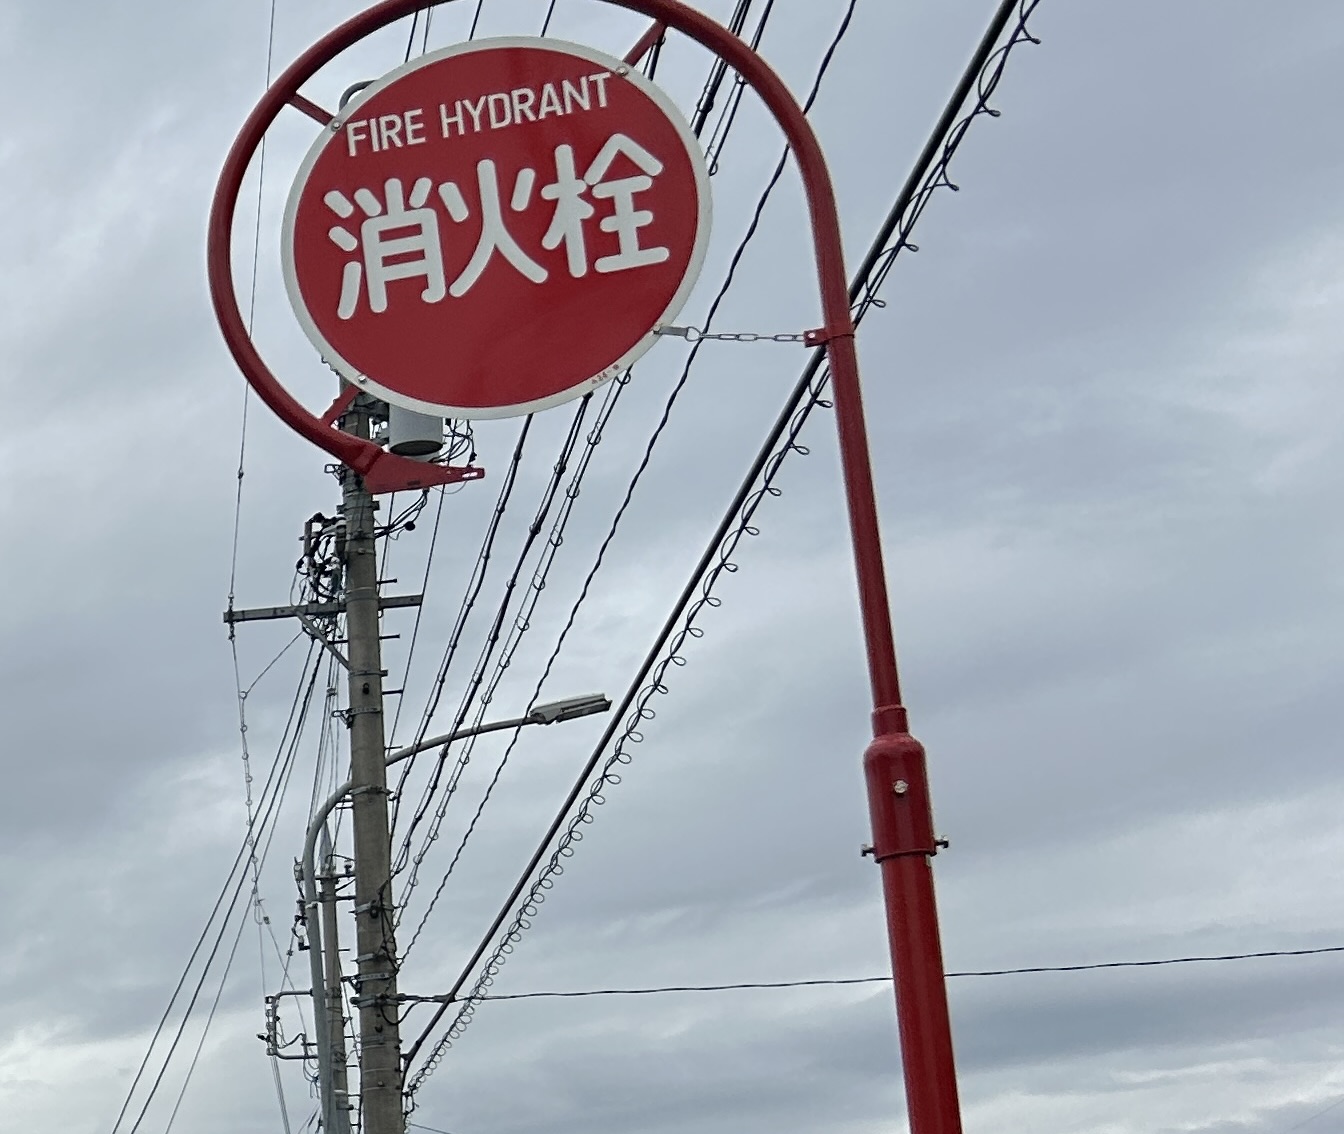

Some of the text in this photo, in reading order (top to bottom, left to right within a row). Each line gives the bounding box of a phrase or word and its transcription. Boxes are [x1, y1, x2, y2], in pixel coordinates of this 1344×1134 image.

[347, 71, 611, 157] FIRE HYDRANT
[324, 132, 670, 320] 消火栓
